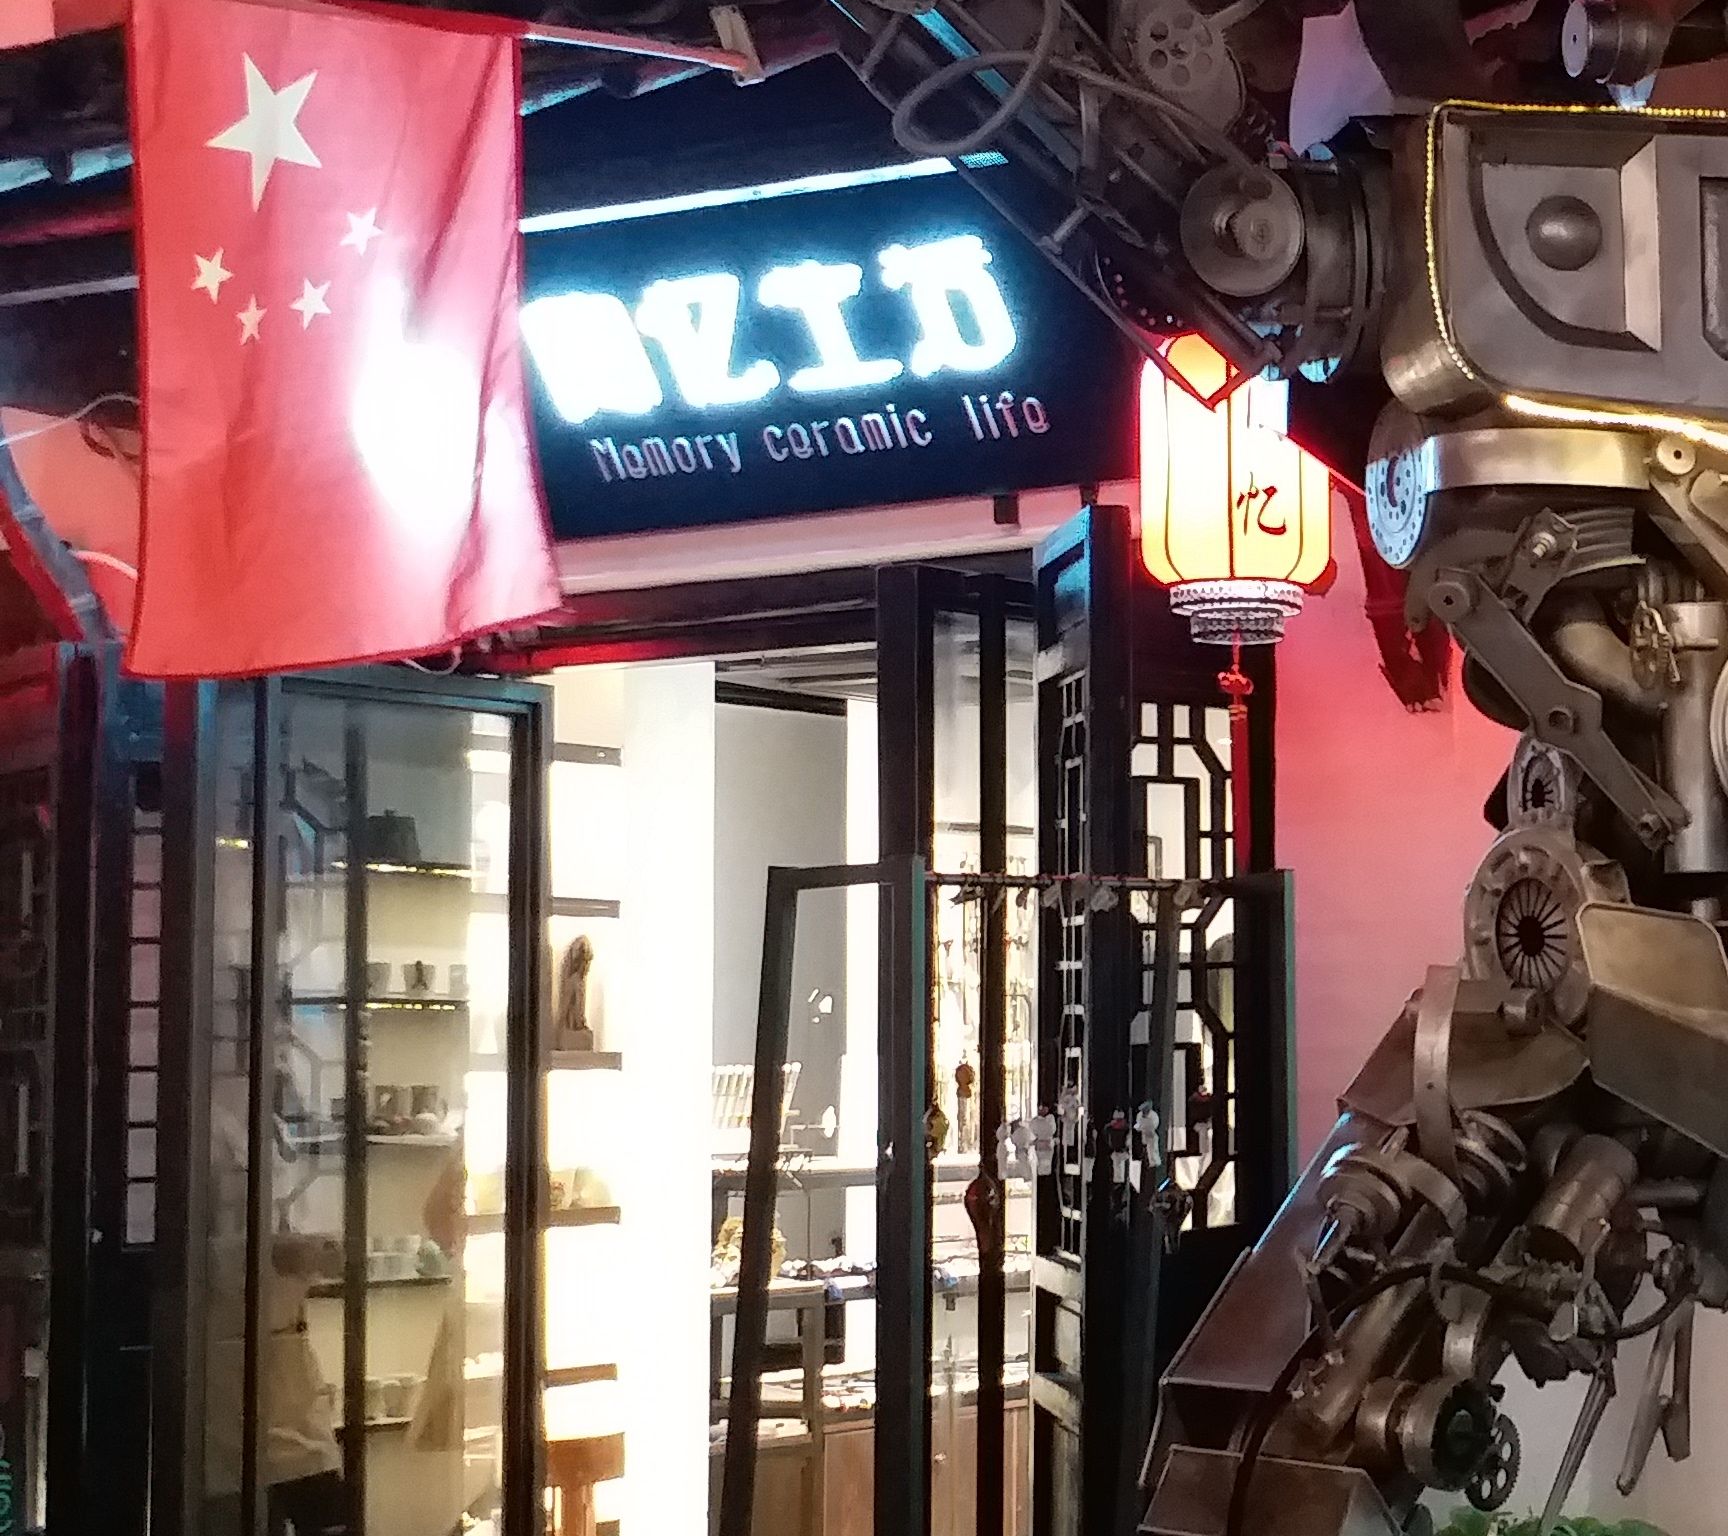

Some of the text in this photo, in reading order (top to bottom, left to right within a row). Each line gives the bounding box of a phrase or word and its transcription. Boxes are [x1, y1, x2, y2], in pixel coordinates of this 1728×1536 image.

[588, 390, 1051, 484] Memory ceramic life
